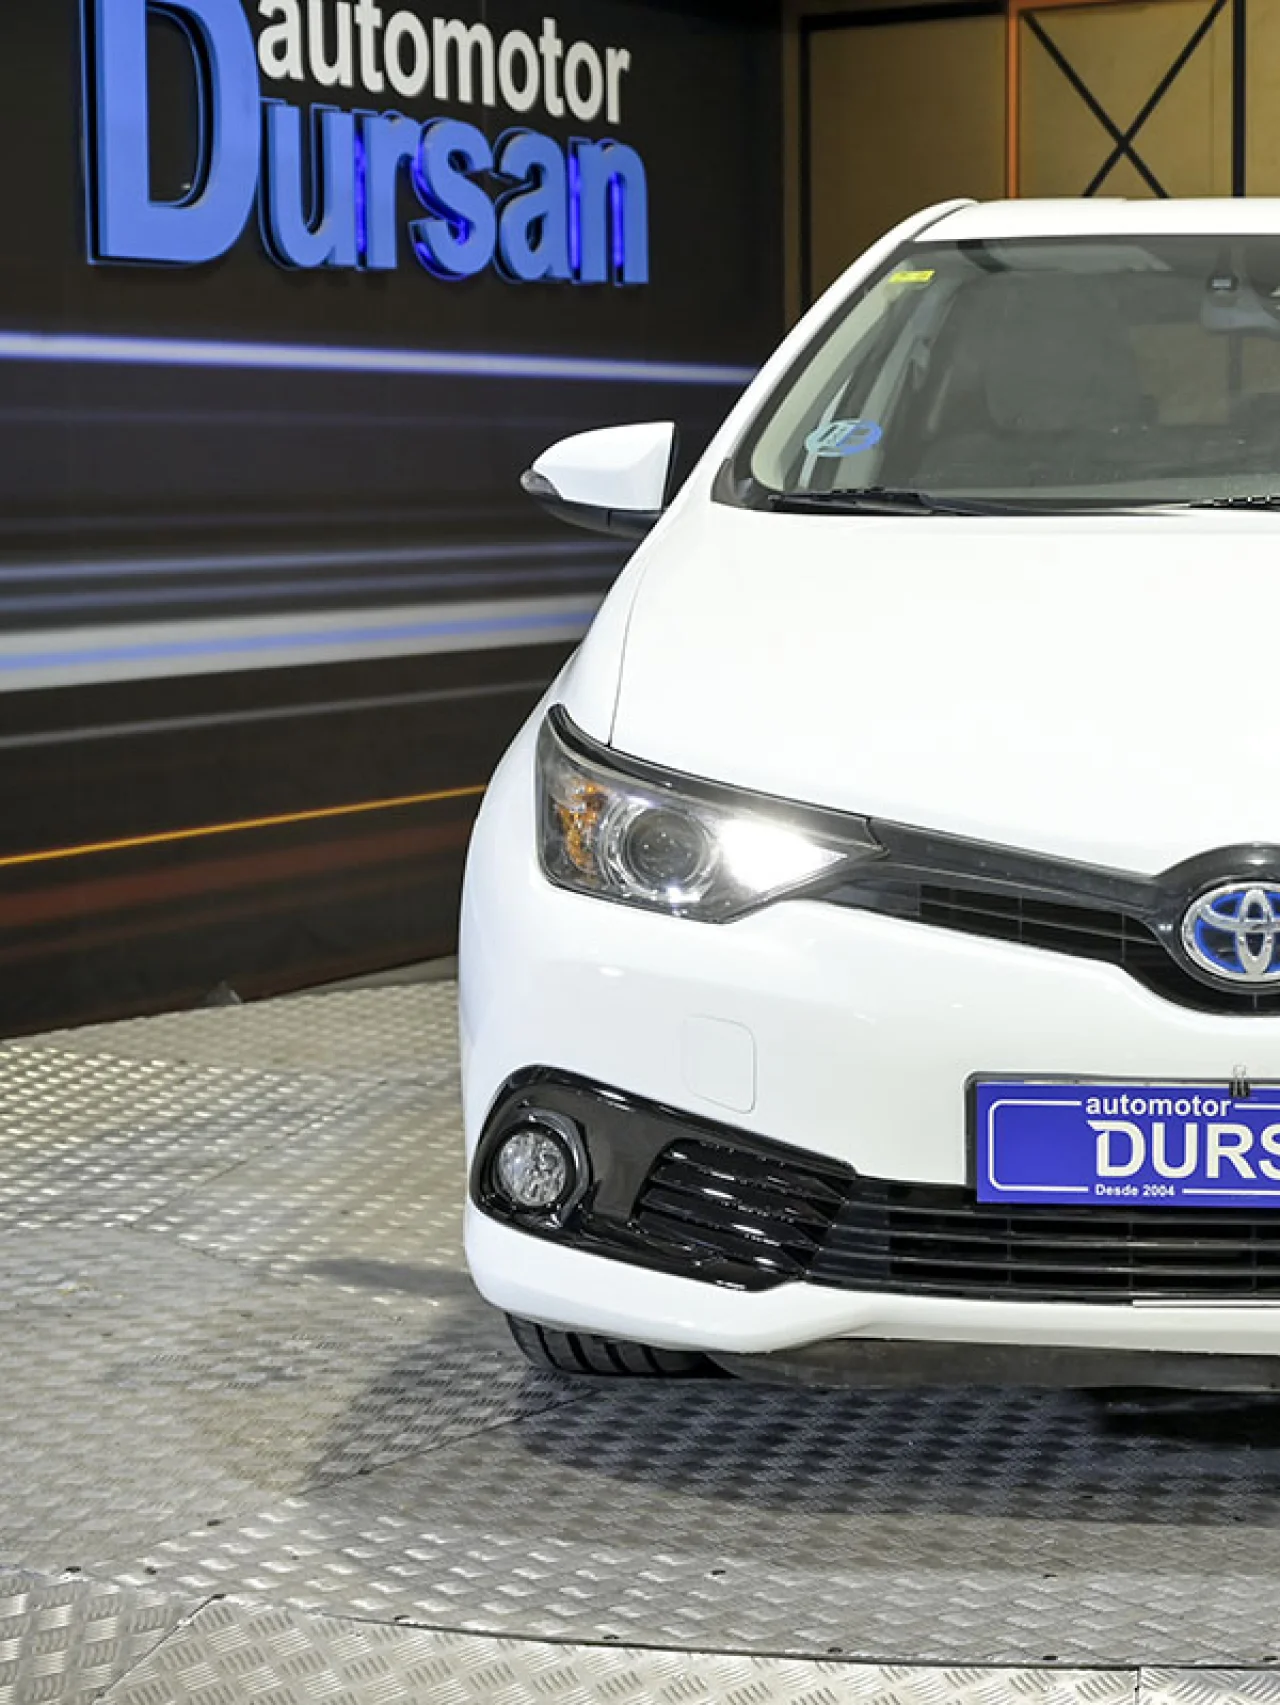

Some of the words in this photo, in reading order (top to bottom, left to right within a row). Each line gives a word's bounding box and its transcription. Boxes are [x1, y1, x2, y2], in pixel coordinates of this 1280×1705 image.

[257, 0, 632, 124] automotor
[82, 0, 649, 286] Dursan
[1086, 1095, 1232, 1118] automotor
[1095, 1184, 1139, 1197] Desde
[1142, 1186, 1175, 1197] 2004
